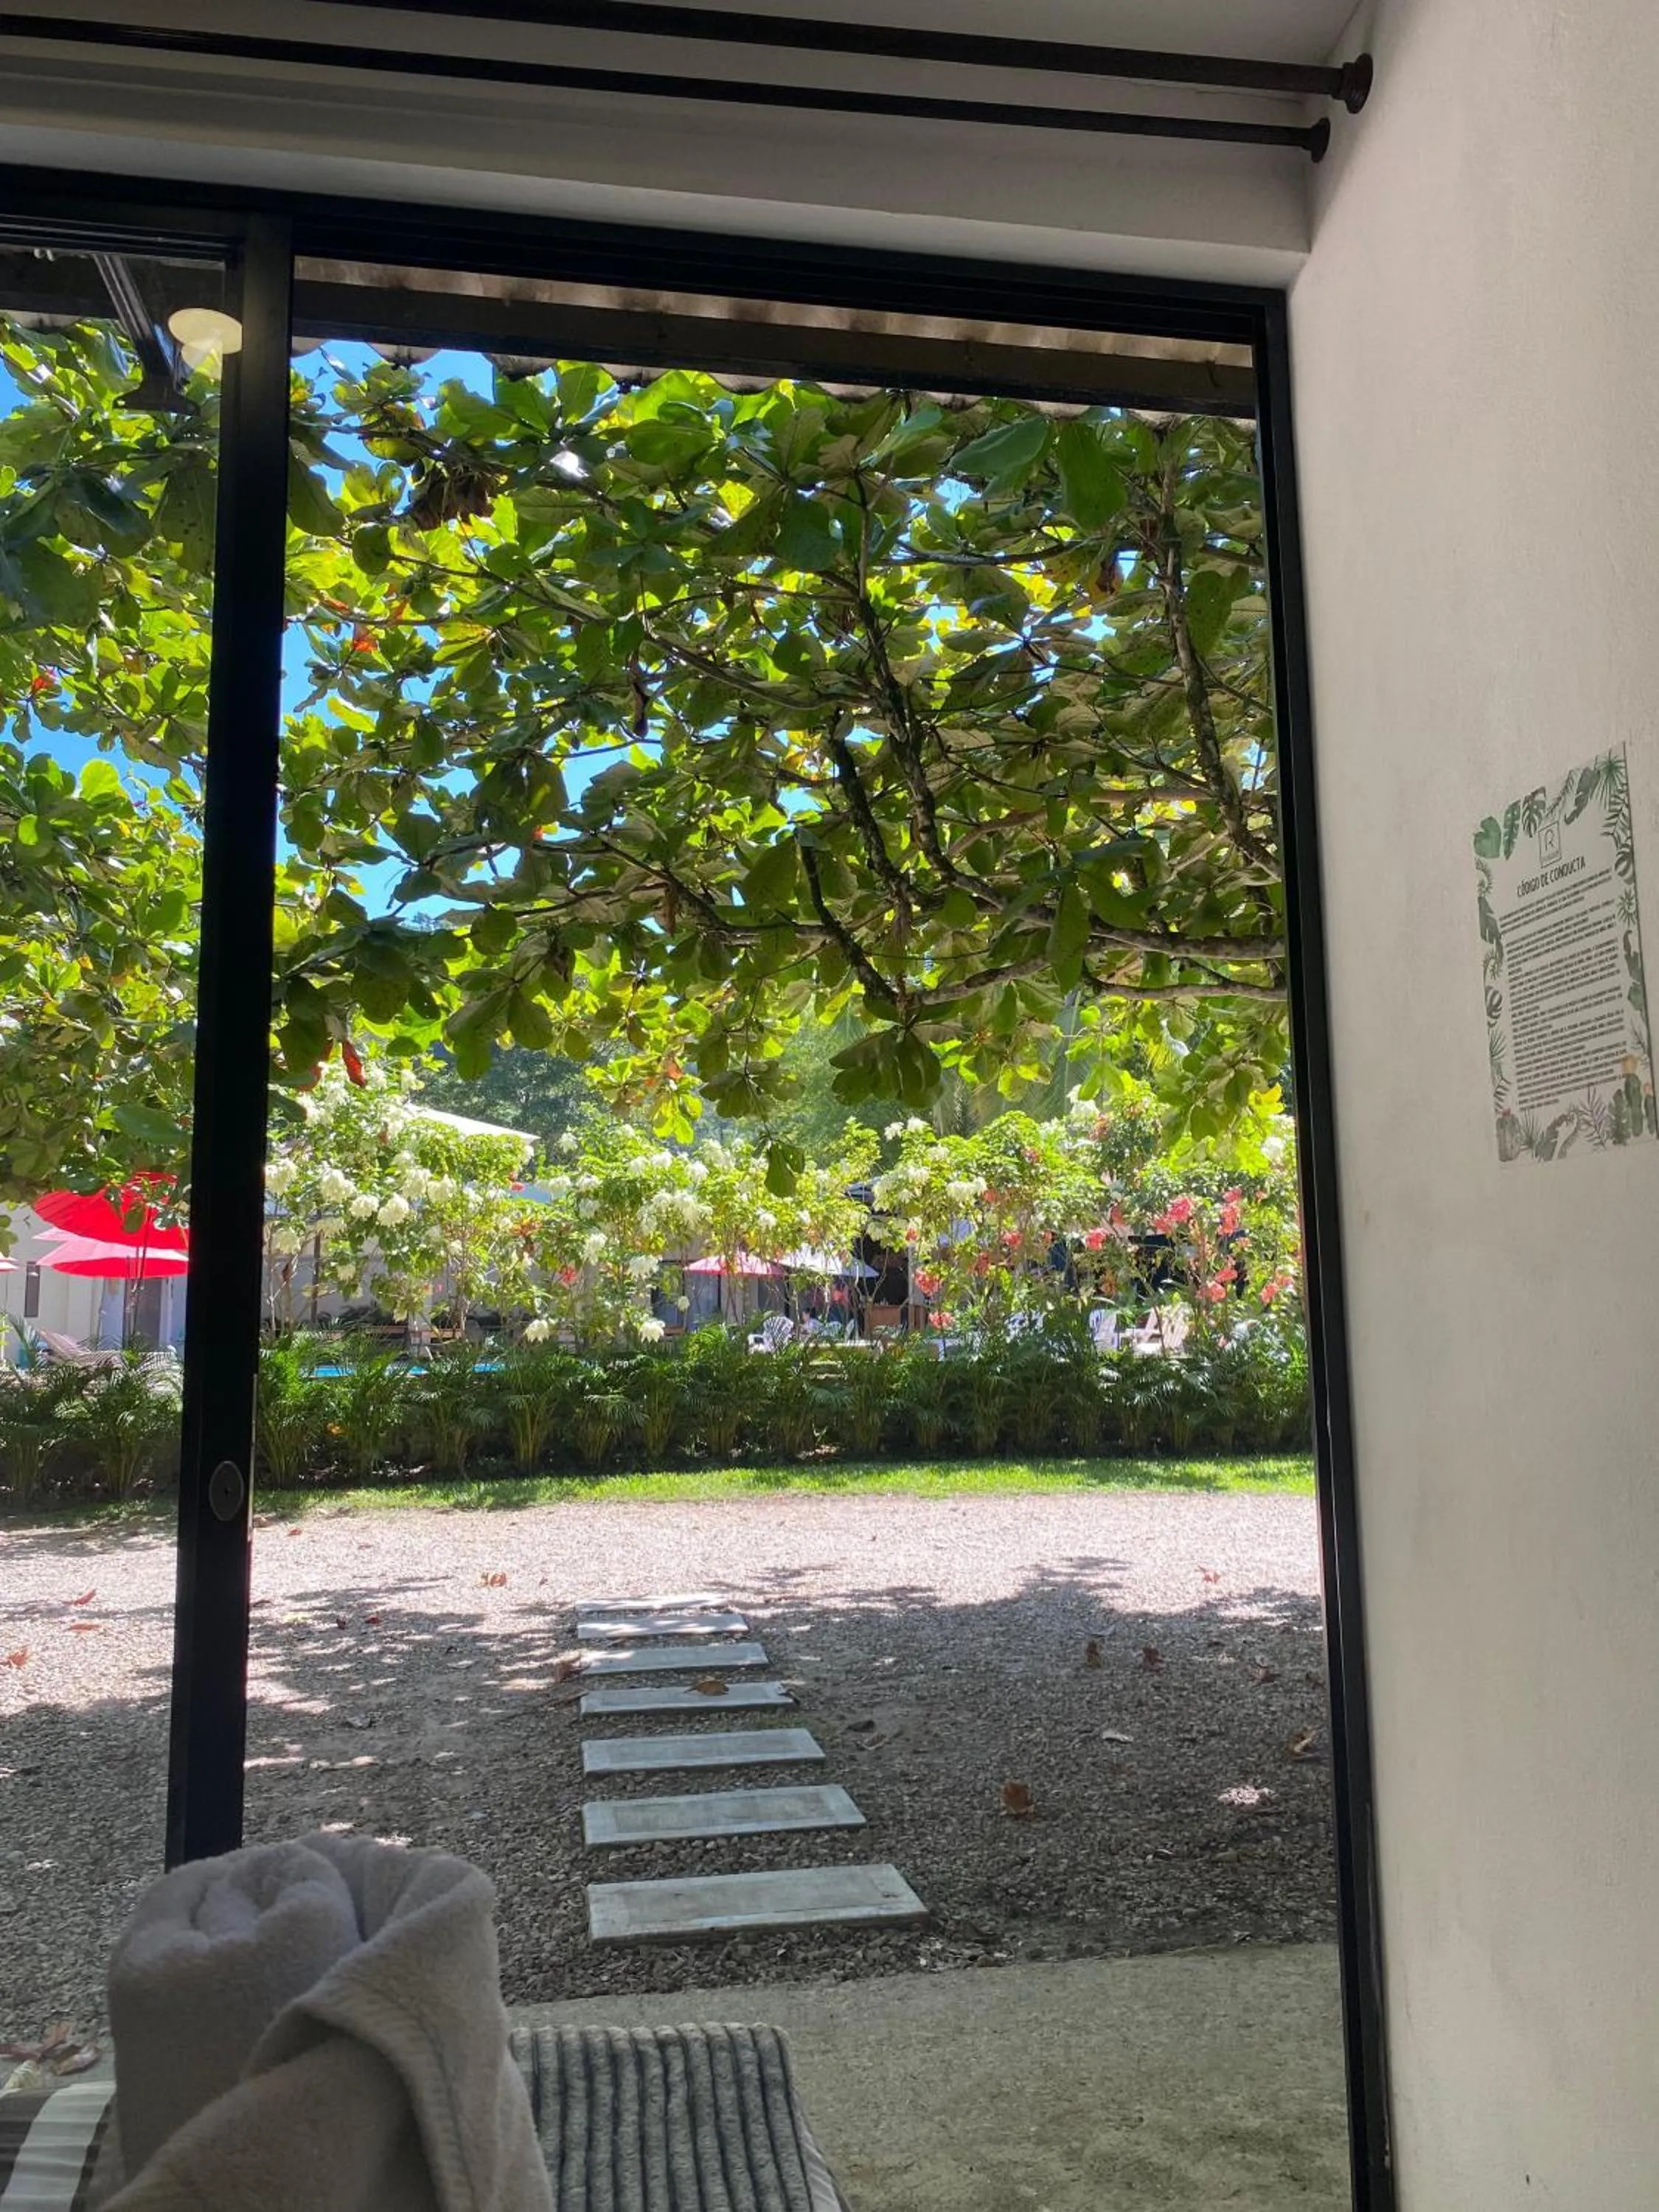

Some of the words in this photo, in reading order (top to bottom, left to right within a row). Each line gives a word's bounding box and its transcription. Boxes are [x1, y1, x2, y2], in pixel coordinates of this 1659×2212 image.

[1517, 876, 1540, 897] CÓDIGO
[1540, 872, 1549, 888] DE
[1549, 855, 1585, 883] CONDUCTA
